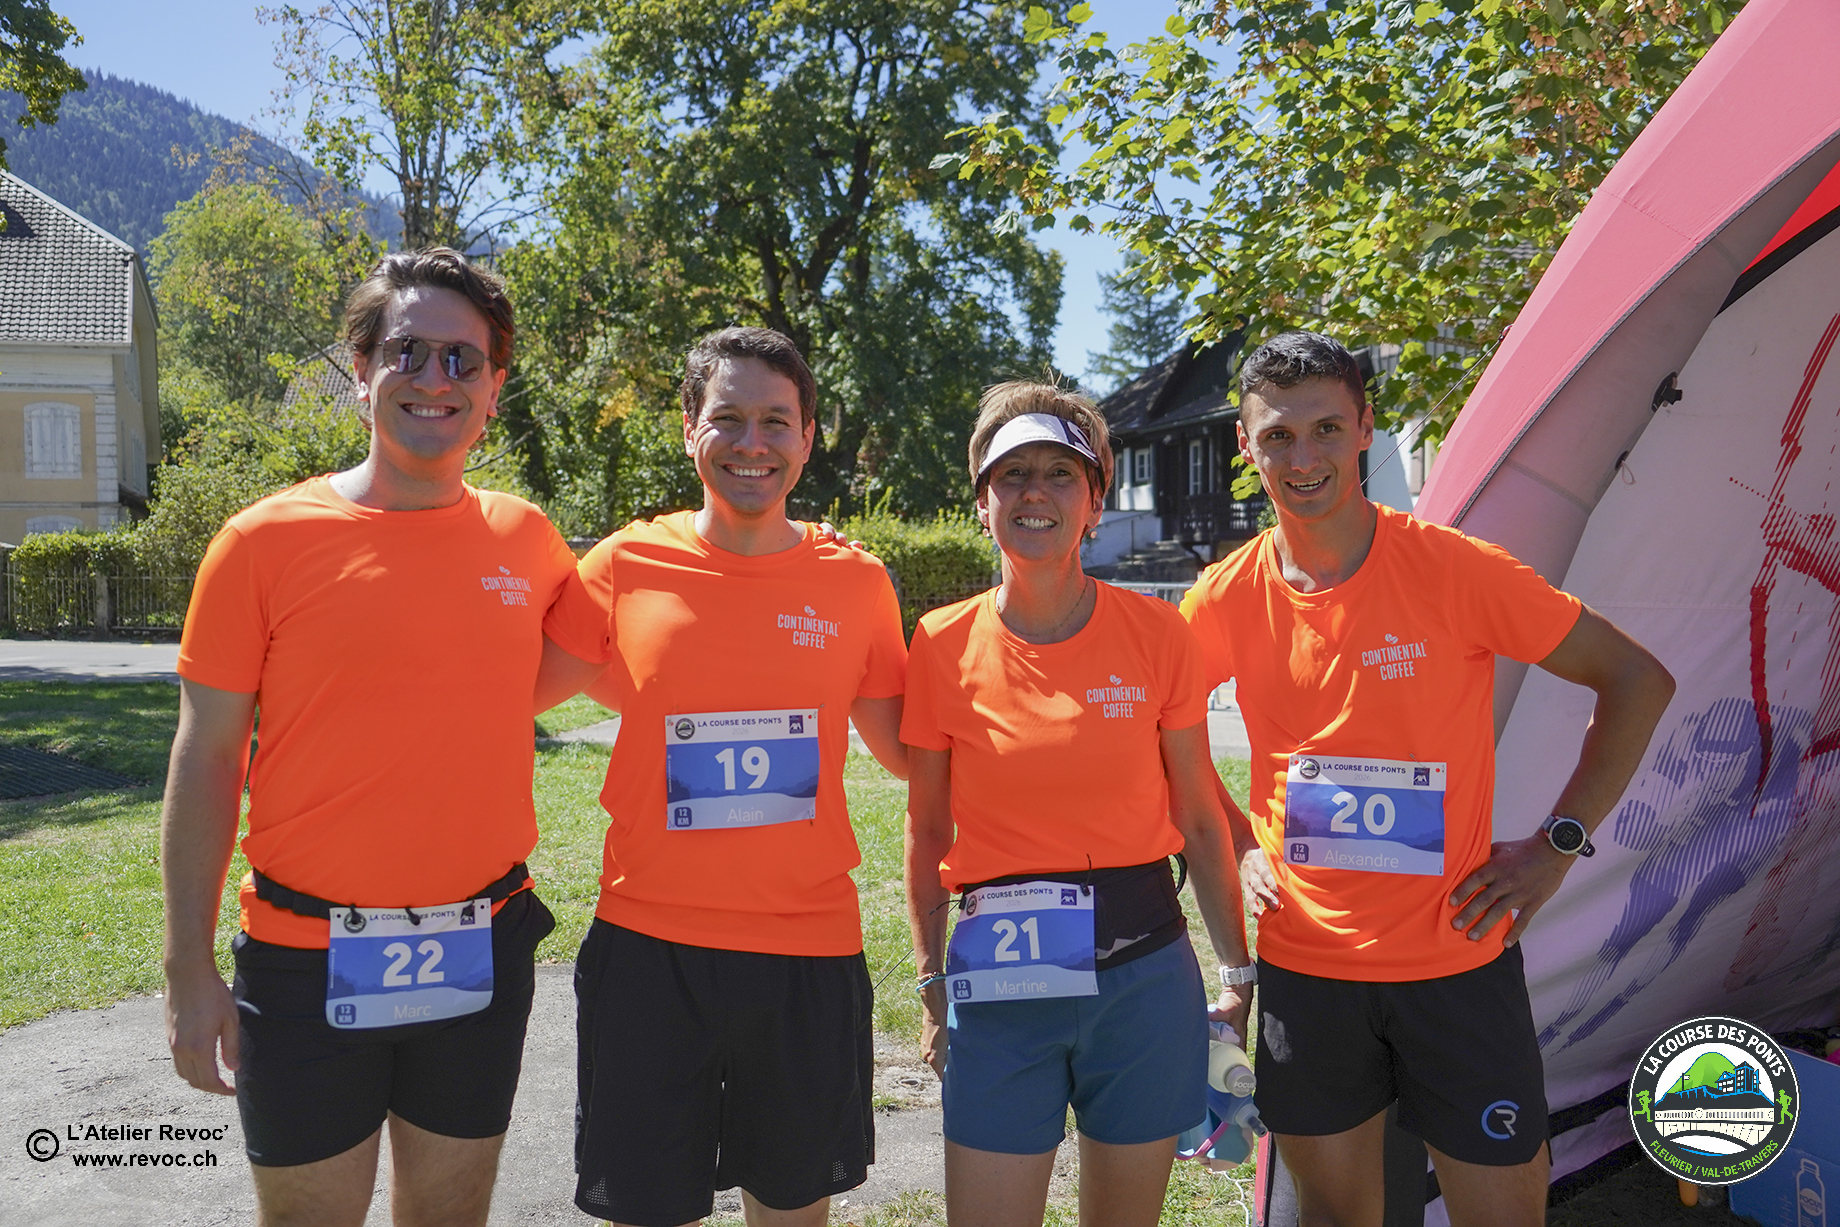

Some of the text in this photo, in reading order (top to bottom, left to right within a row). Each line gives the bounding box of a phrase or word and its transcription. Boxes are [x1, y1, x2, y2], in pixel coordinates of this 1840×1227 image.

[481, 577, 532, 592] CONTINENTAL
[500, 591, 528, 606] COFFEE
[777, 613, 839, 637] CONTINENTAL
[792, 631, 826, 649] COFFEE
[1362, 642, 1427, 667] CONTINENTAL
[1380, 661, 1415, 681] COFFEE
[1086, 686, 1147, 704] CONTINENTAL
[1103, 703, 1134, 718] COFFEE
[709, 719, 740, 727] COURSE
[715, 746, 770, 790] 19
[1334, 764, 1362, 772] COURSE
[678, 817, 689, 825] KM
[727, 808, 763, 823] Alain
[1331, 791, 1396, 836] 20
[1294, 853, 1305, 861] KM
[1323, 850, 1399, 868] Alexandre
[987, 891, 1012, 899] COURSE
[992, 917, 1041, 963] 21
[382, 939, 445, 987] 22
[957, 981, 967, 989] 12
[995, 979, 1048, 995] Martine
[956, 990, 969, 998] KM
[341, 1005, 351, 1014] 12
[394, 1004, 432, 1020] Marc
